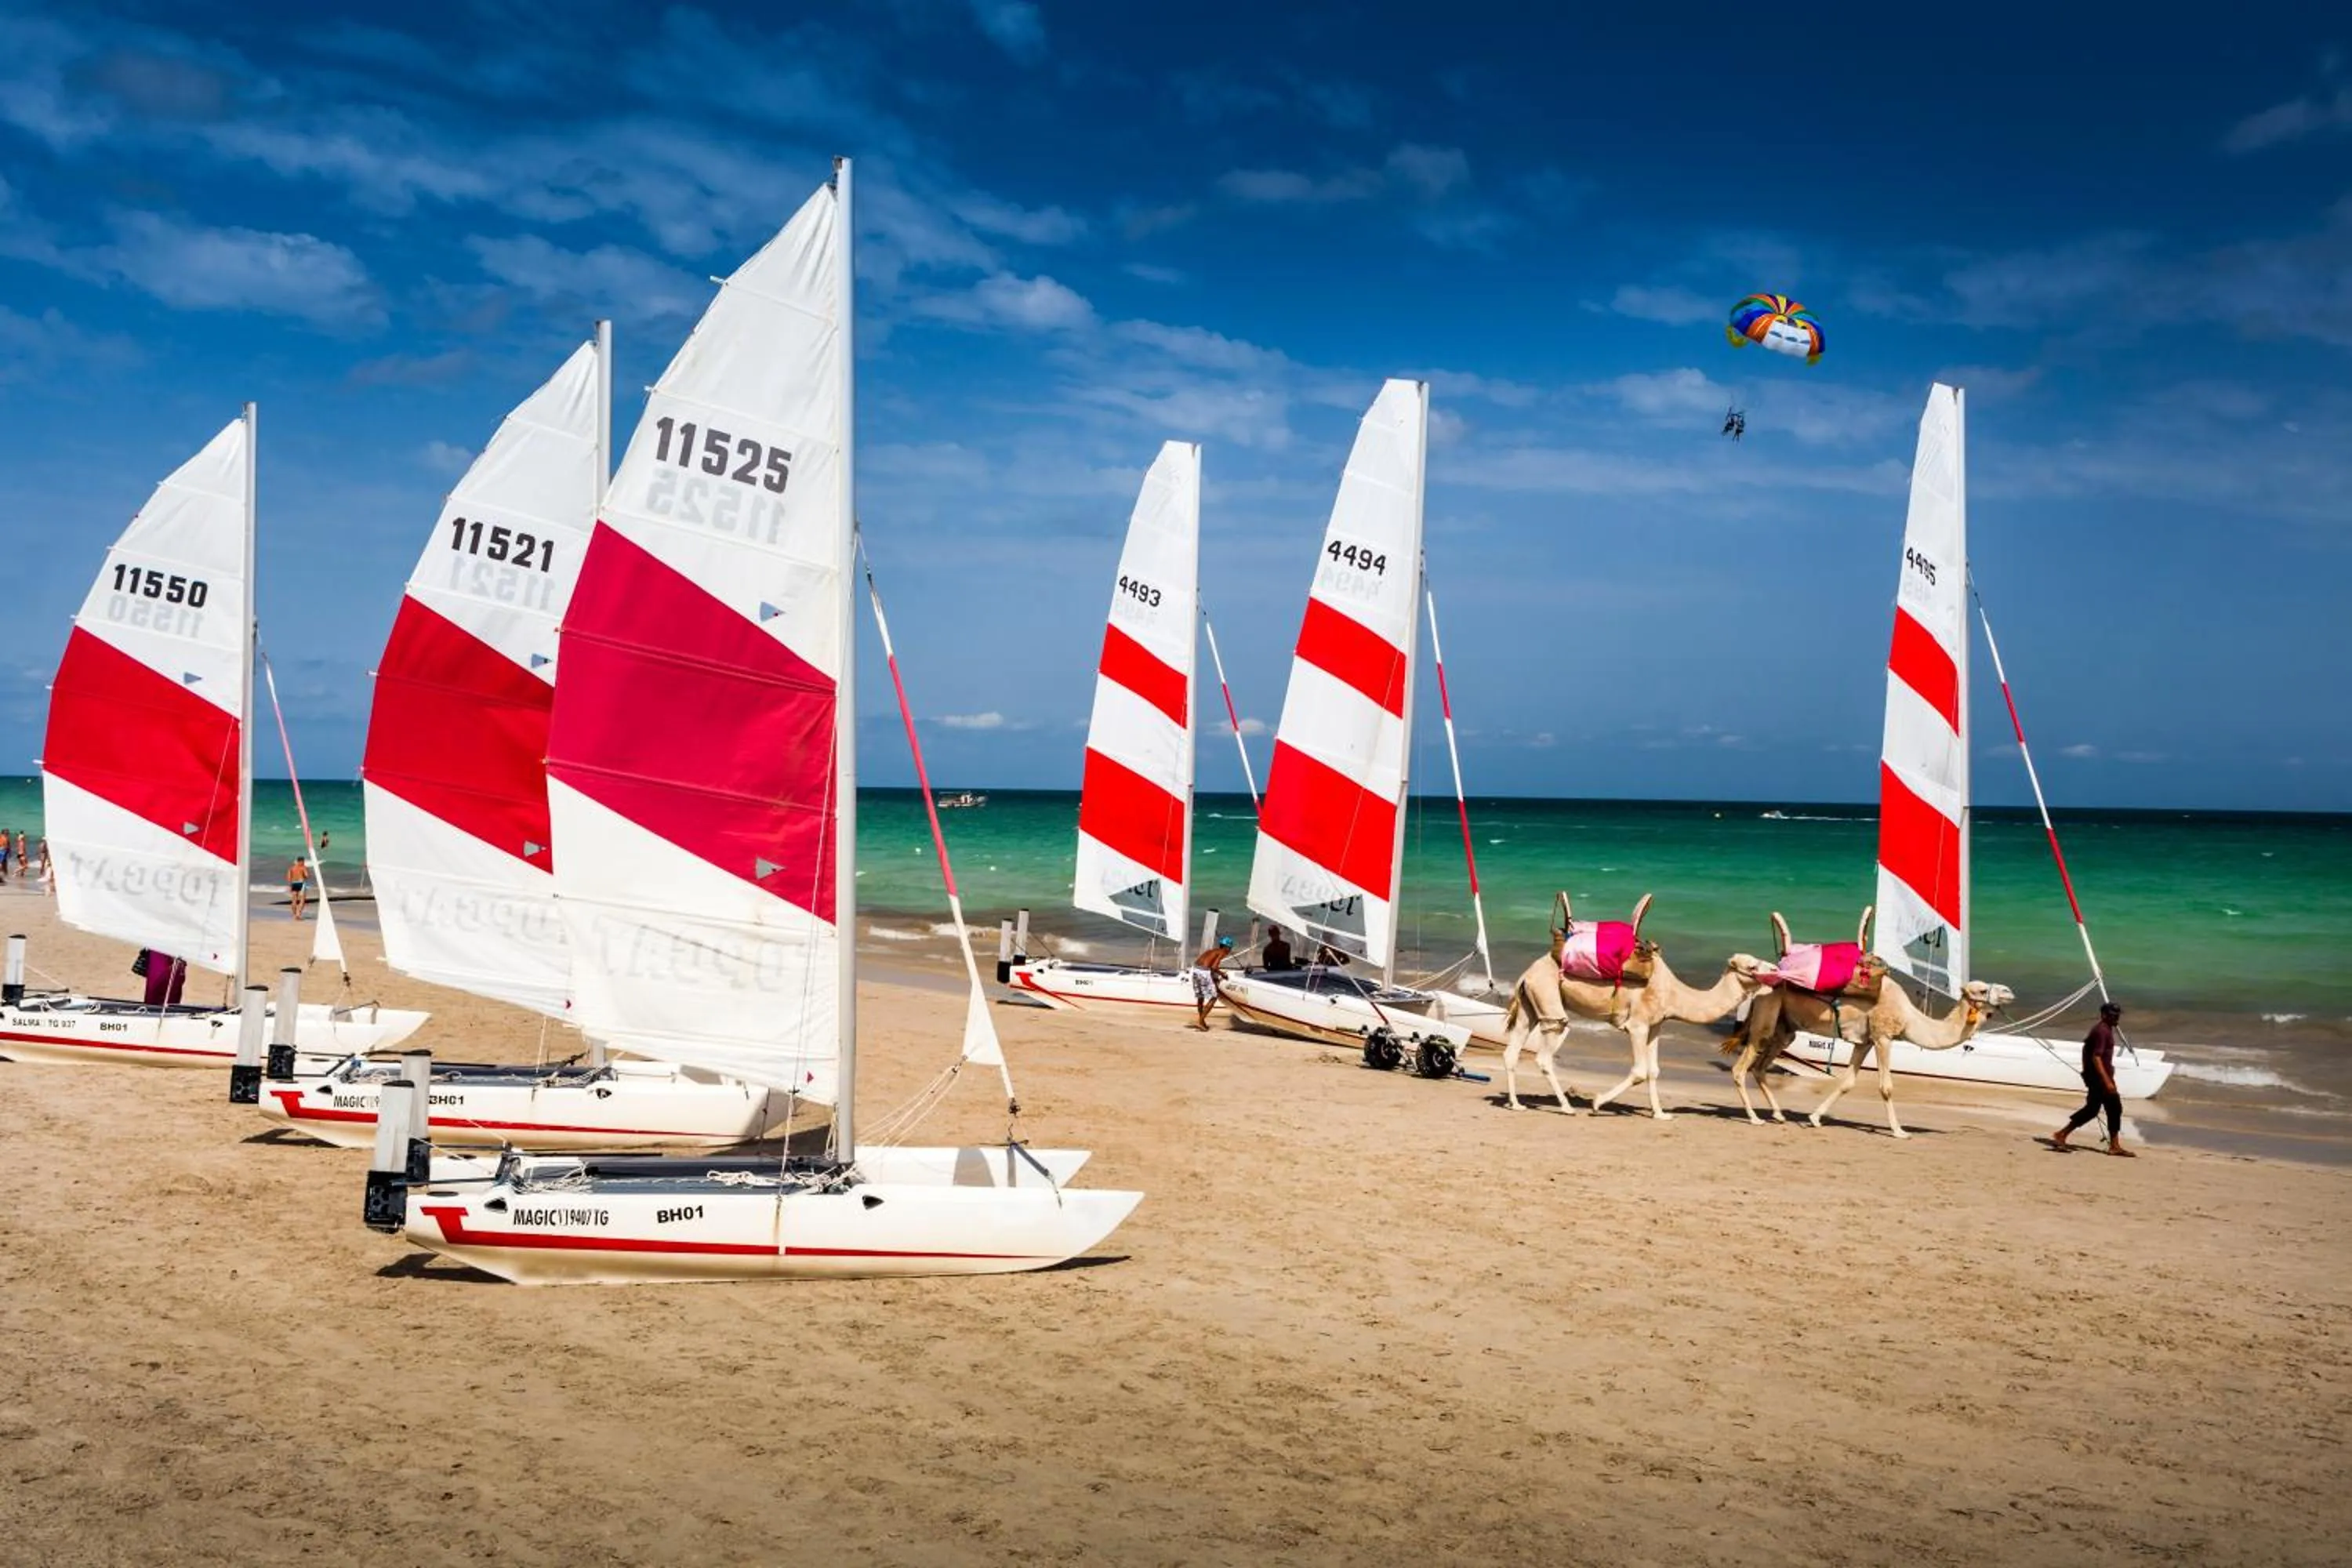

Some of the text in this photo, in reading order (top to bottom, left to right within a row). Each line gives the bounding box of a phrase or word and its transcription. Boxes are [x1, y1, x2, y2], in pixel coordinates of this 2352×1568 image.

[655, 416, 793, 495] 11525
[451, 517, 554, 573] 11521
[1327, 539, 1386, 576] 4494
[113, 564, 209, 608] 11550
[1119, 575, 1161, 608] 4493
[100, 1022, 129, 1032] BH01
[333, 1094, 365, 1108] MAGIC
[513, 1208, 557, 1226] MAGIC
[593, 1208, 610, 1225] TG
[655, 1204, 704, 1225] BH01
